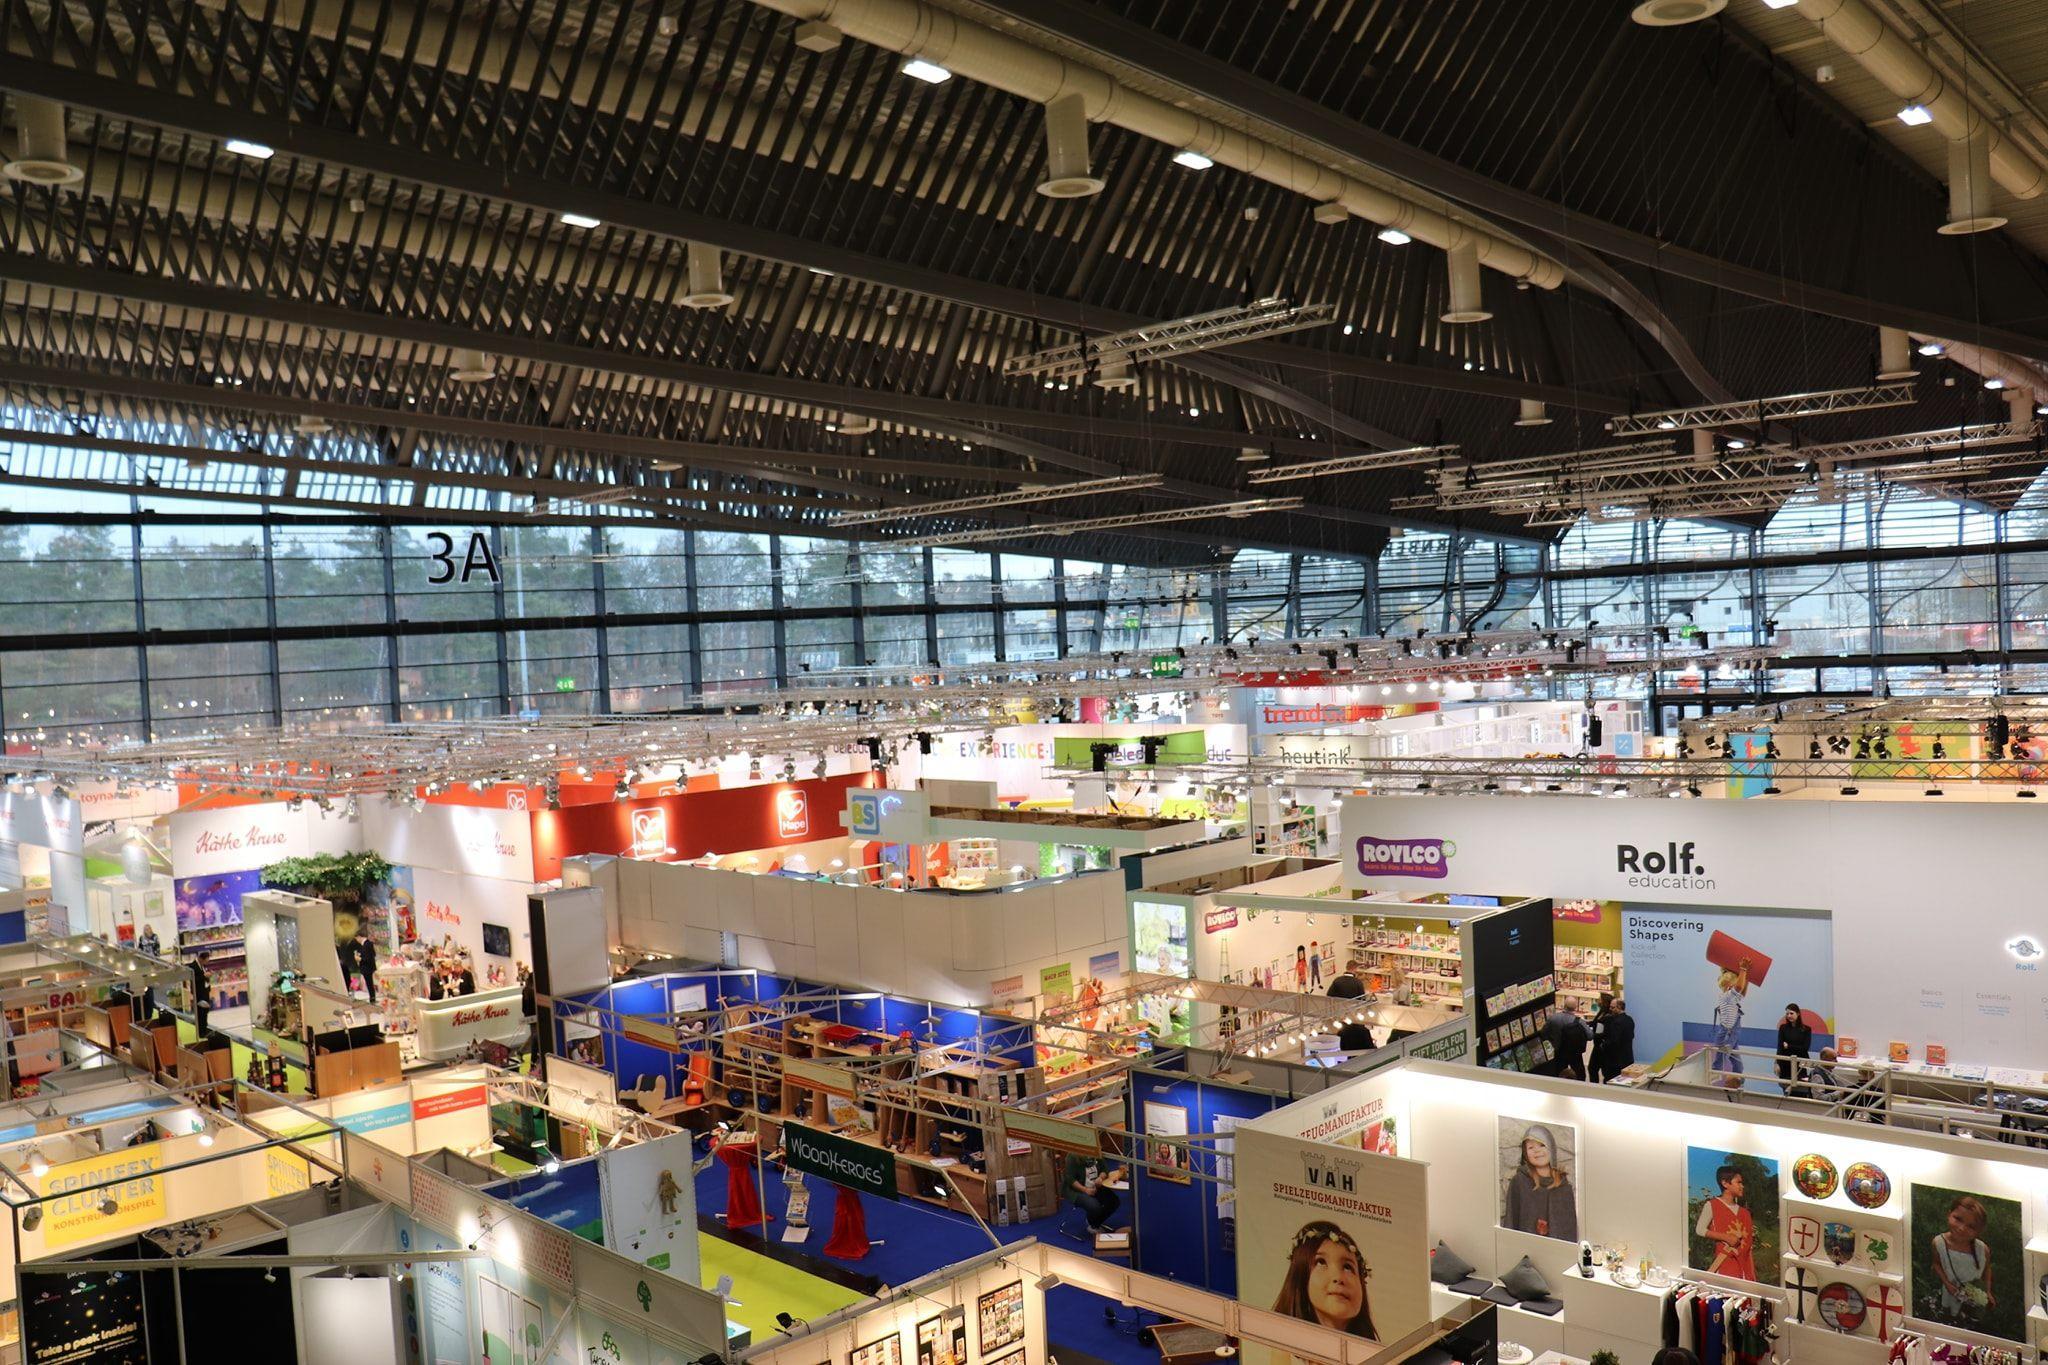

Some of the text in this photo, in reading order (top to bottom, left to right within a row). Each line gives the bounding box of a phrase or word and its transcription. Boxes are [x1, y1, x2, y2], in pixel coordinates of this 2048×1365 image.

[427, 531, 500, 584] 3A
[1363, 844, 1440, 864] ROYLCO
[1617, 842, 1705, 875] Rolf.
[1628, 875, 1716, 890] education
[1629, 917, 1704, 932] Discovering
[1630, 929, 1674, 942] Shapes
[1432, 1039, 1450, 1054] IDEA
[1299, 1099, 1384, 1140] ZEUGMANUFAKTUR
[1308, 1167, 1353, 1191] VAH
[1273, 1182, 1392, 1217] SPIELZEUGMANUFAKTUR
[35, 1345, 63, 1359] Take
[73, 1333, 100, 1350] peek
